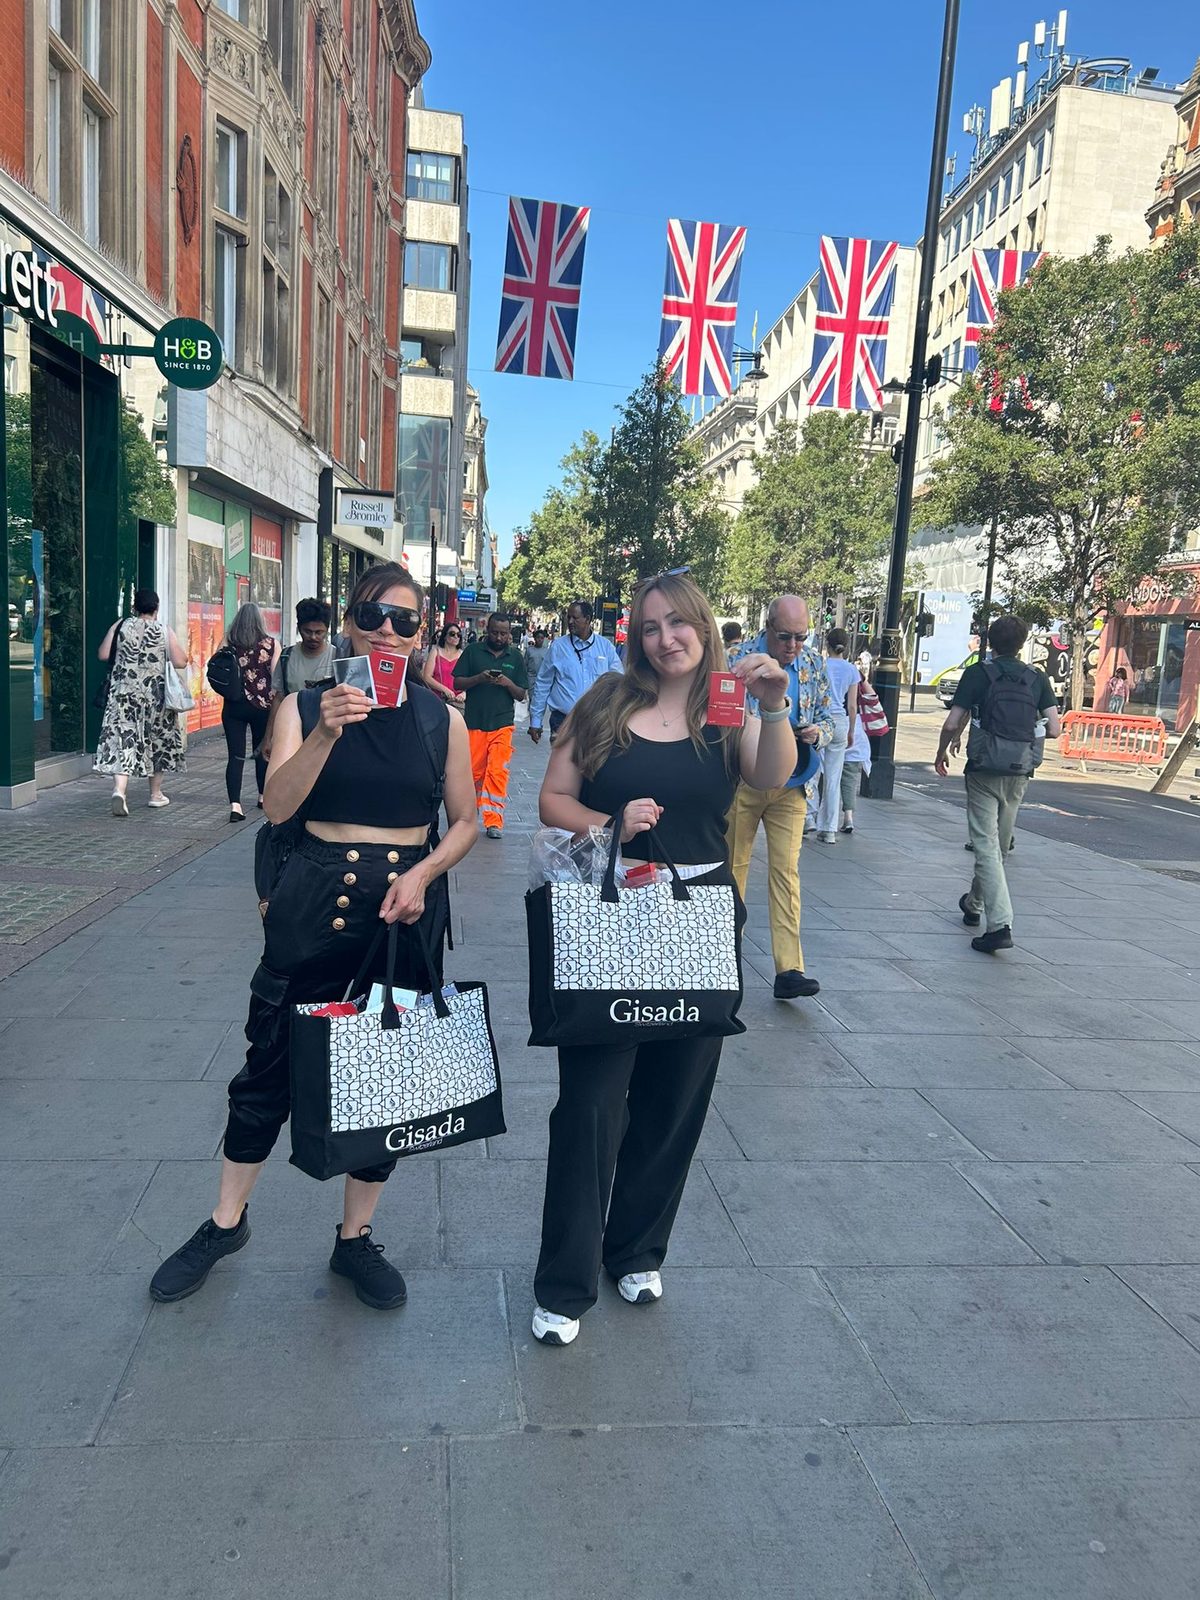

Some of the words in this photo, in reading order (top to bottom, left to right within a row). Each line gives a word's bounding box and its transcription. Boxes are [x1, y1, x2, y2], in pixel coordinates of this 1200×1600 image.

[164, 337, 212, 360] H&B
[164, 361, 190, 370] SINCE
[193, 363, 211, 371] 1870
[351, 500, 384, 512] Russell
[344, 509, 388, 524] Bromley
[608, 998, 700, 1023] Gisada
[385, 1113, 466, 1152] Gisada
